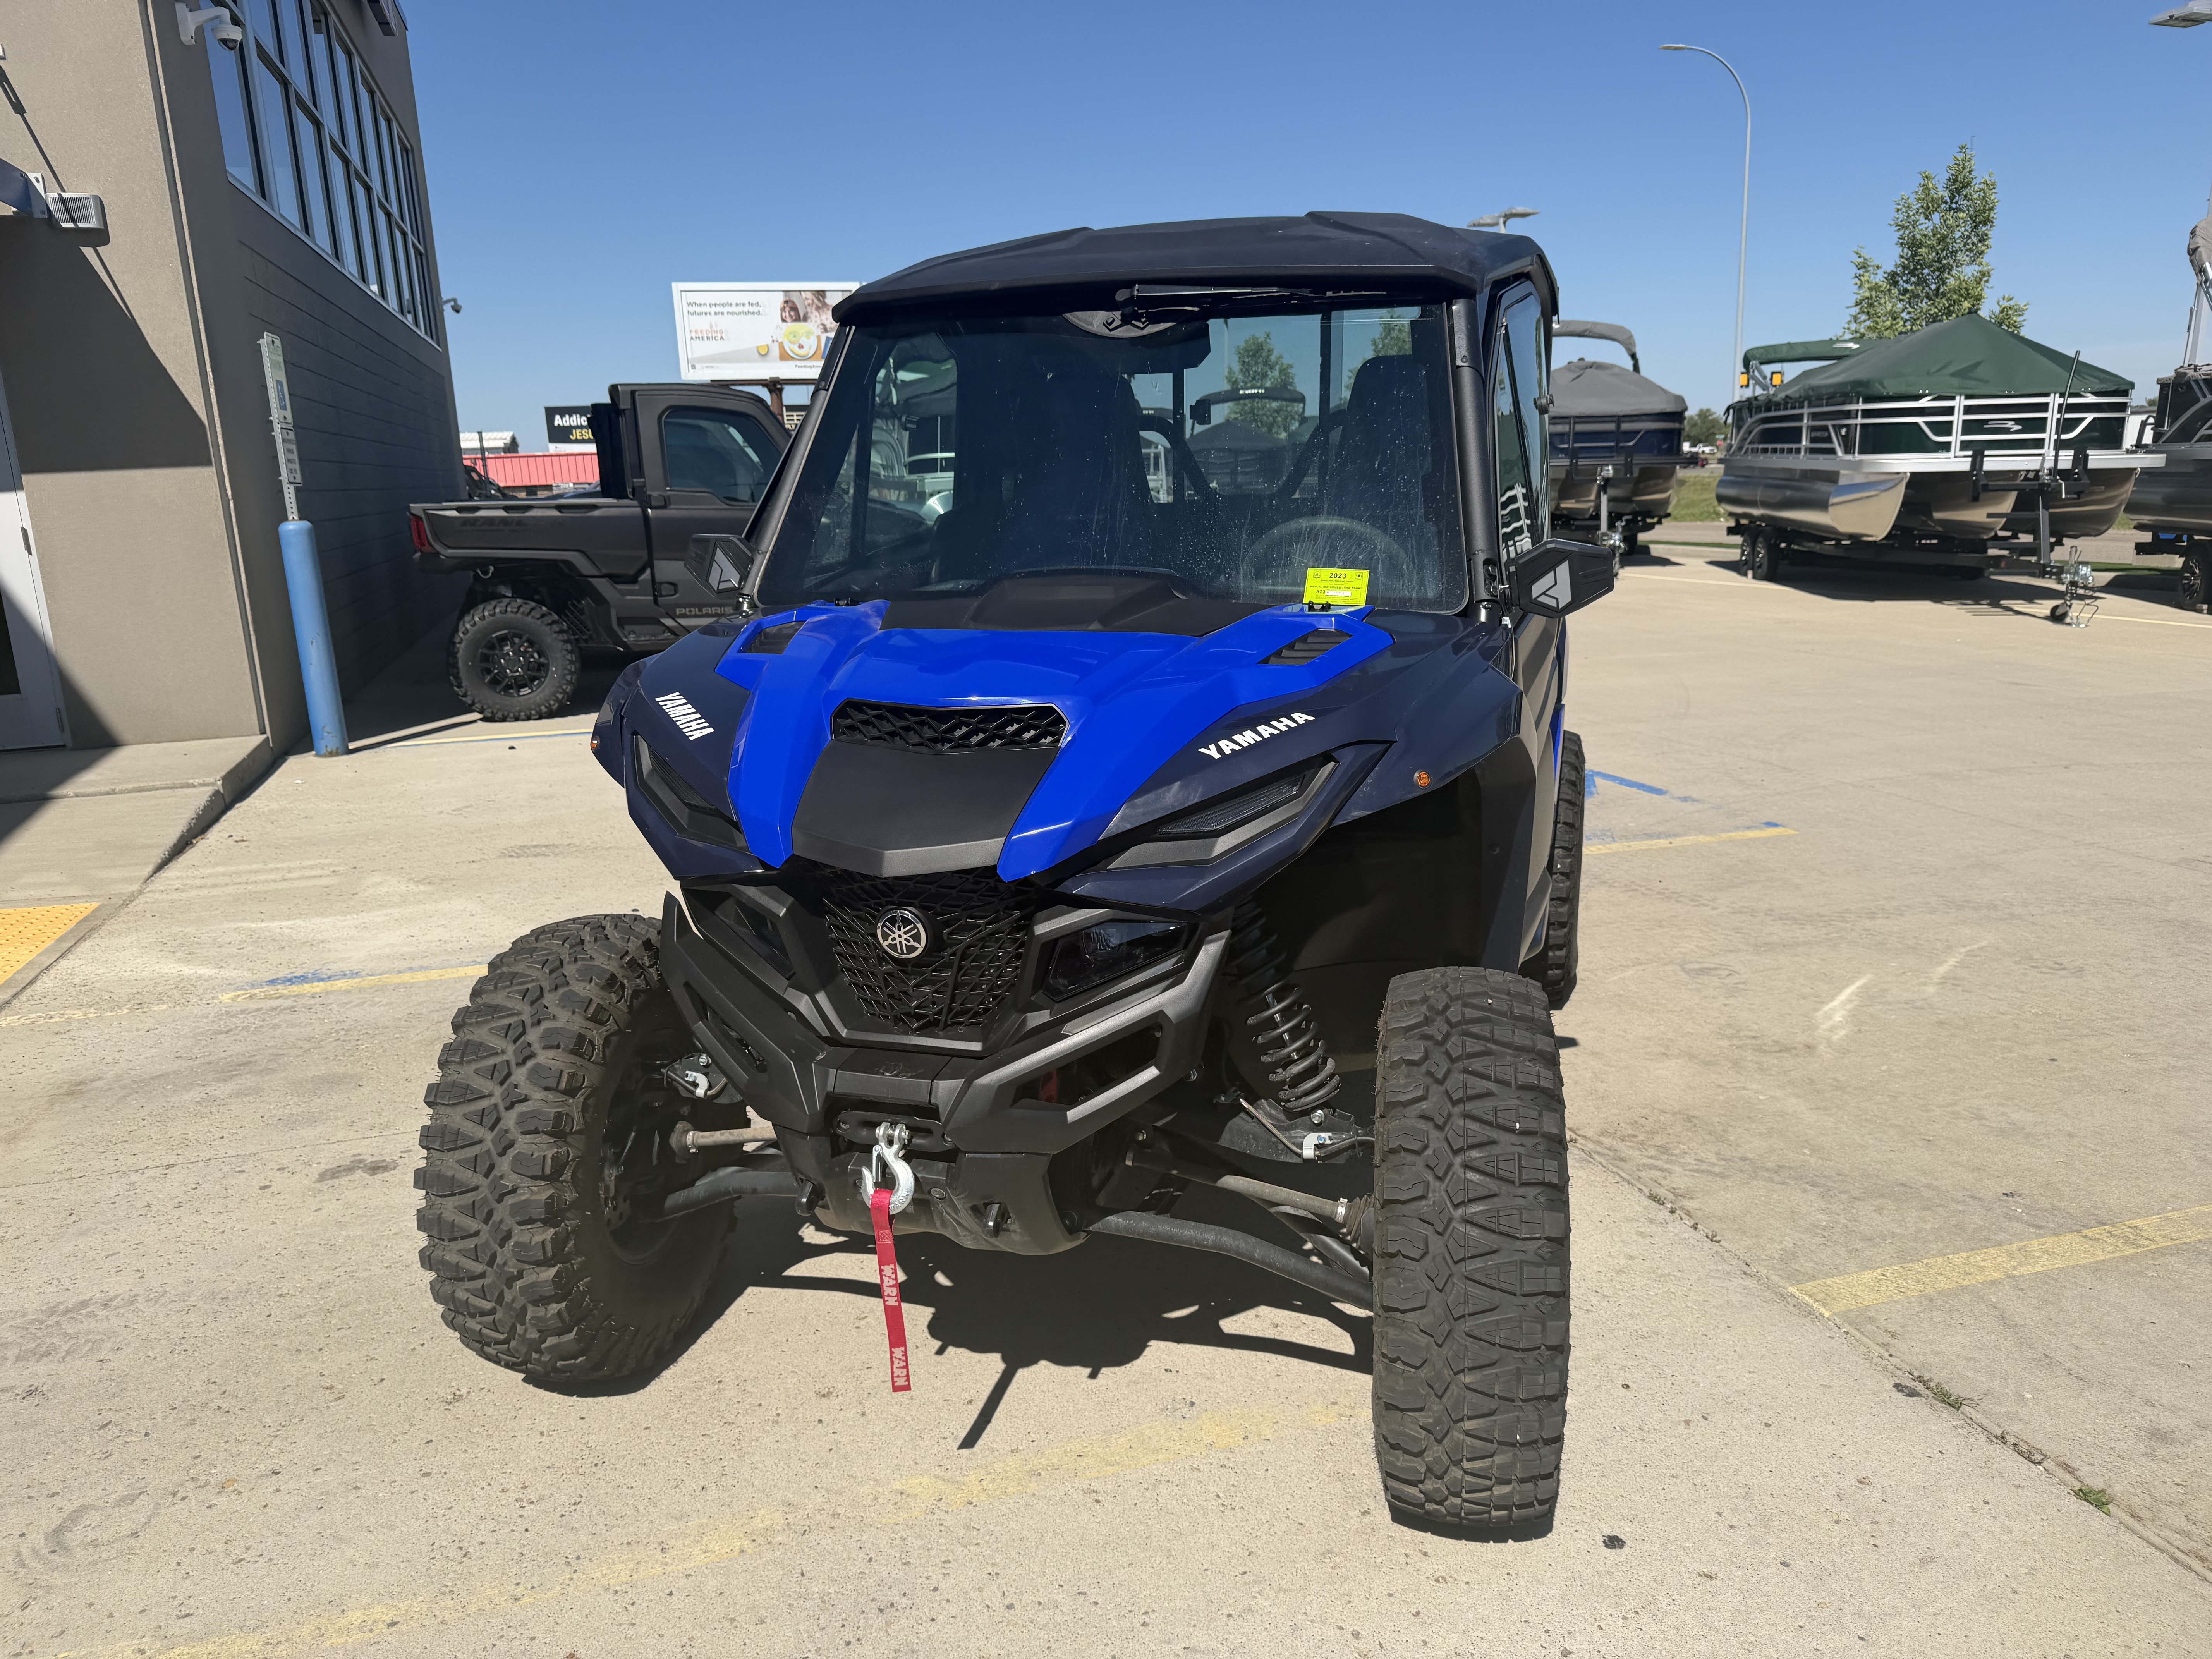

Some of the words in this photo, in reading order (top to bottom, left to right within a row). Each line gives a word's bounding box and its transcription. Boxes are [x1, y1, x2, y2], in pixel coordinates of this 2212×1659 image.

[689, 327, 724, 335] FEEDING
[554, 414, 591, 426] Addic
[676, 606, 733, 615] POLARIS
[655, 692, 714, 740] YAMAHA
[1198, 712, 1316, 759] YAMAHA
[881, 1264, 898, 1306] WARN
[892, 1346, 908, 1386] WARN
